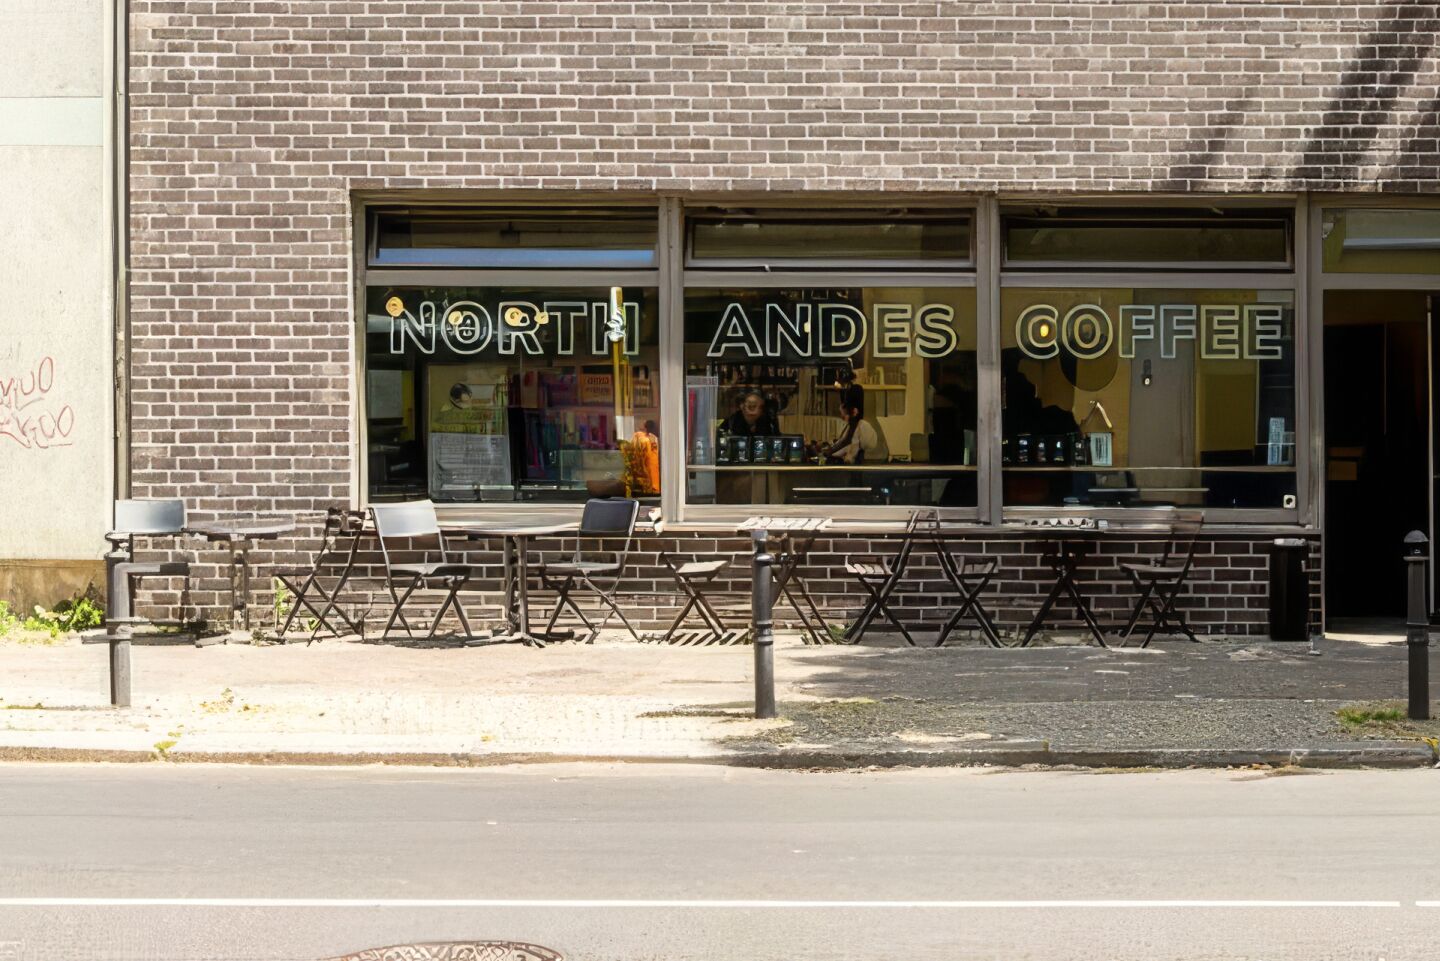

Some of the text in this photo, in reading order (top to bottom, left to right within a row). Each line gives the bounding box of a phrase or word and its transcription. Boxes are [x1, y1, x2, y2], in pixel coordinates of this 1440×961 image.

[389, 300, 1284, 360] NORTH ANDES COFFEE
